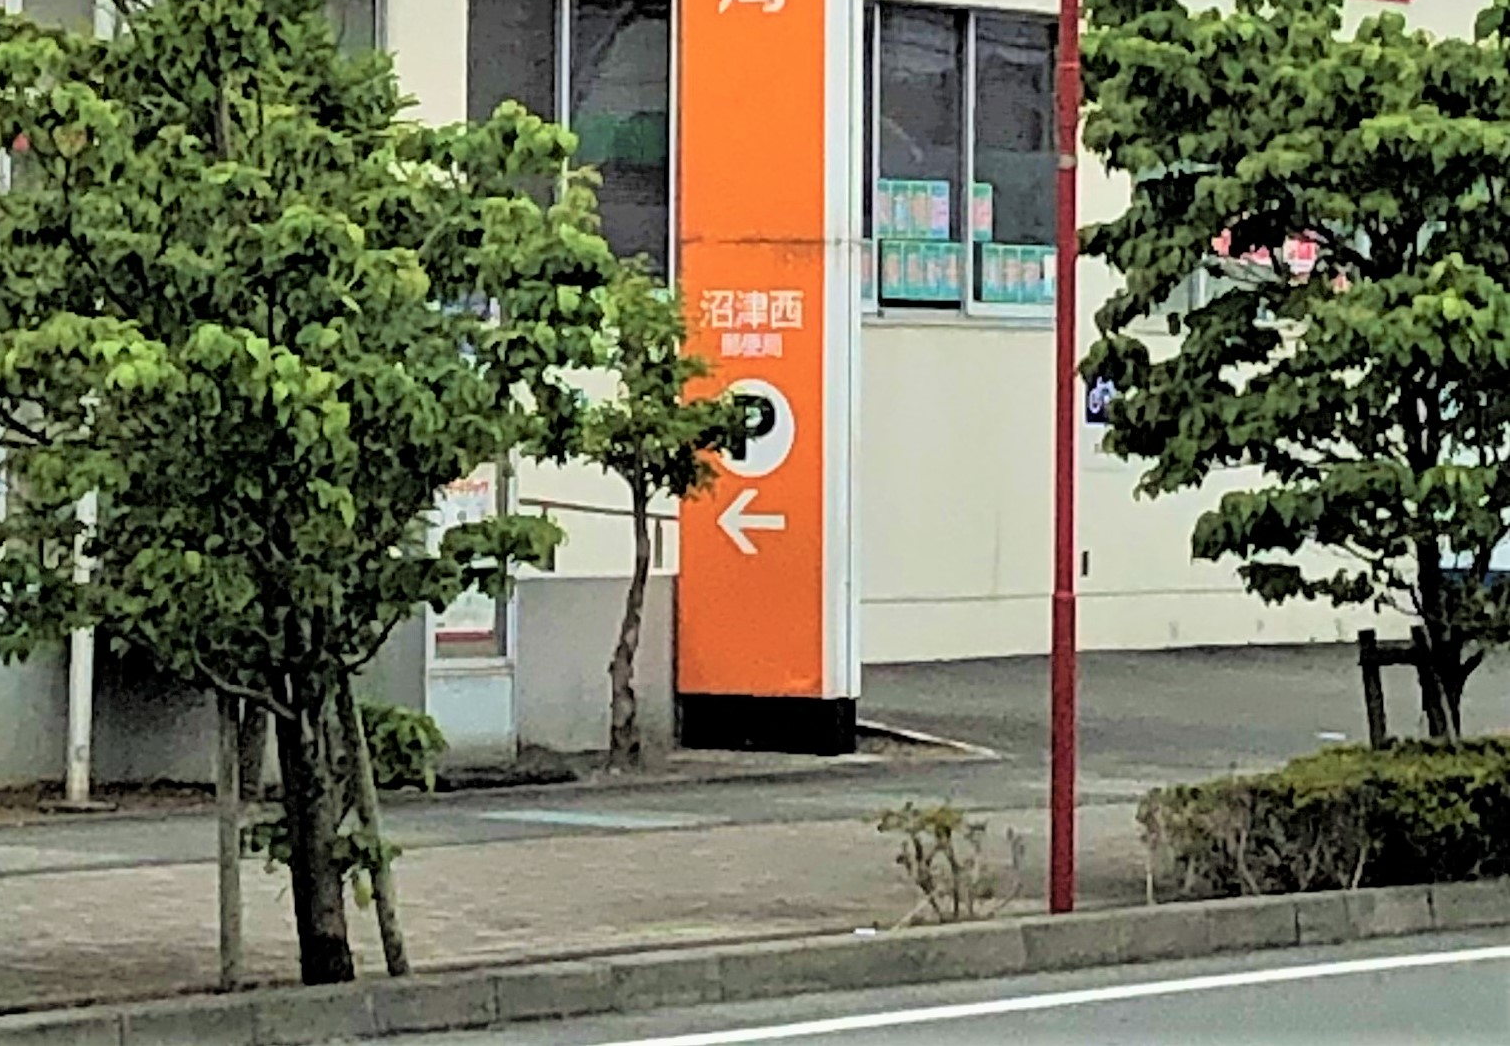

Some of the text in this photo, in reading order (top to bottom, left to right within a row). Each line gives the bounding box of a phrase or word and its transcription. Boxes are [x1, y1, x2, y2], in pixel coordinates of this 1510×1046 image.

[700, 290, 805, 329] 沼津西
[731, 394, 775, 461] P
